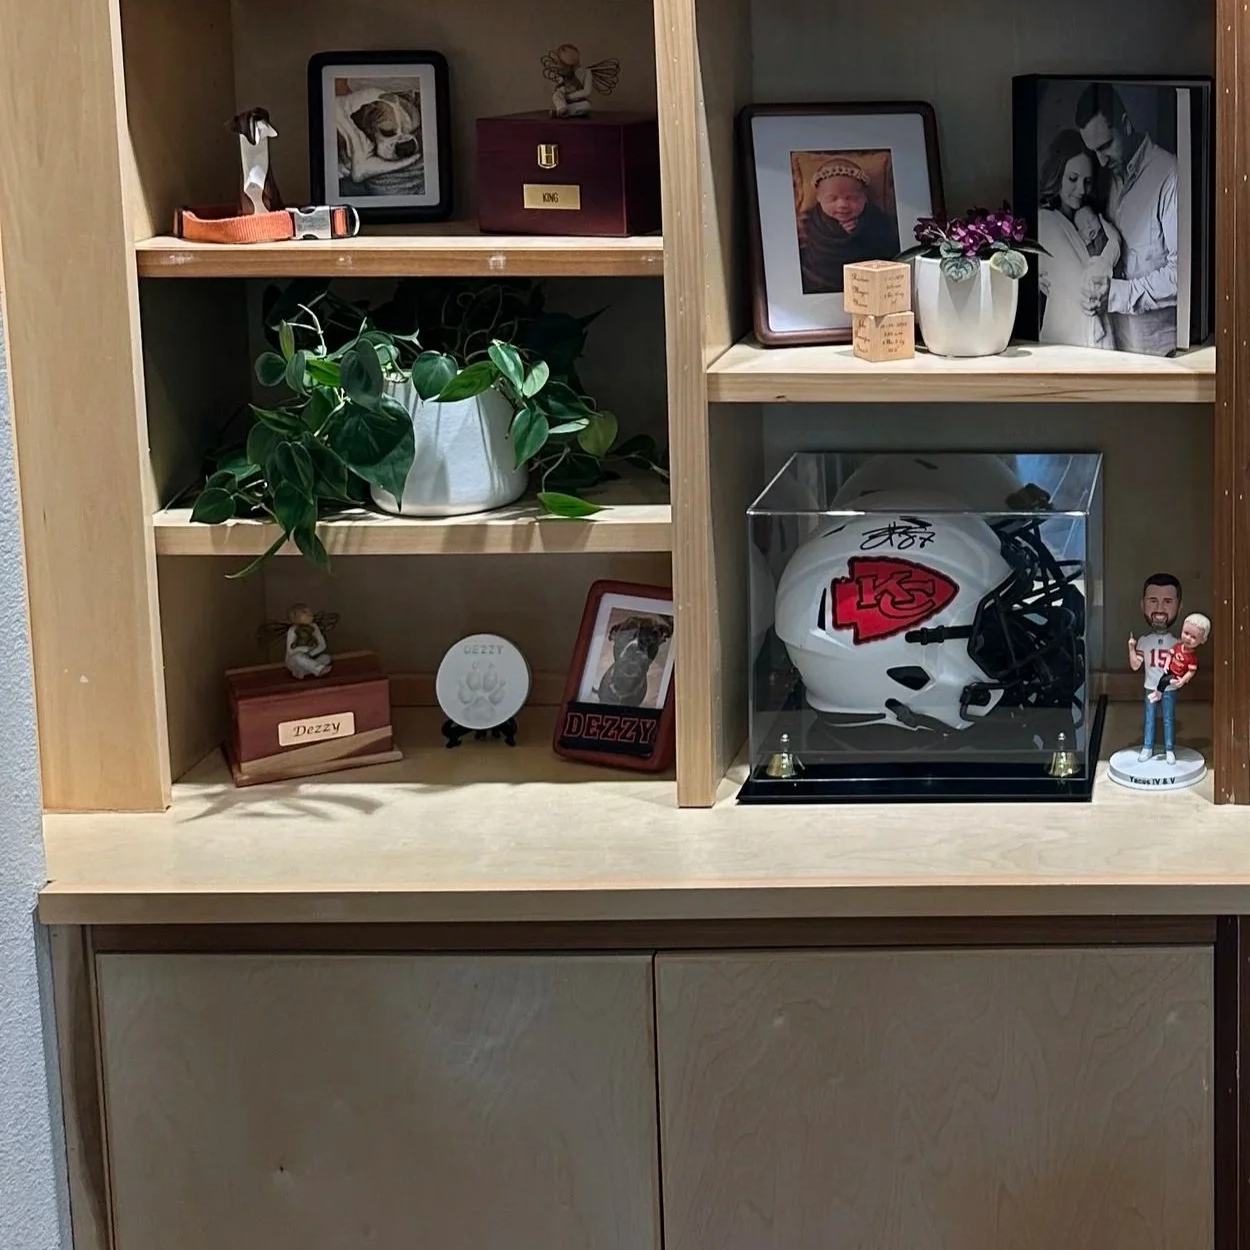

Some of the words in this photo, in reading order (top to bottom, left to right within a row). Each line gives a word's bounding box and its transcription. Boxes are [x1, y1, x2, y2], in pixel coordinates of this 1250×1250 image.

[543, 192, 559, 203] KING
[855, 570, 936, 619] KC
[463, 644, 504, 655] DEZZY
[1150, 648, 1169, 669] 15
[293, 722, 341, 737] Dezzy
[563, 712, 657, 744] DEZZY
